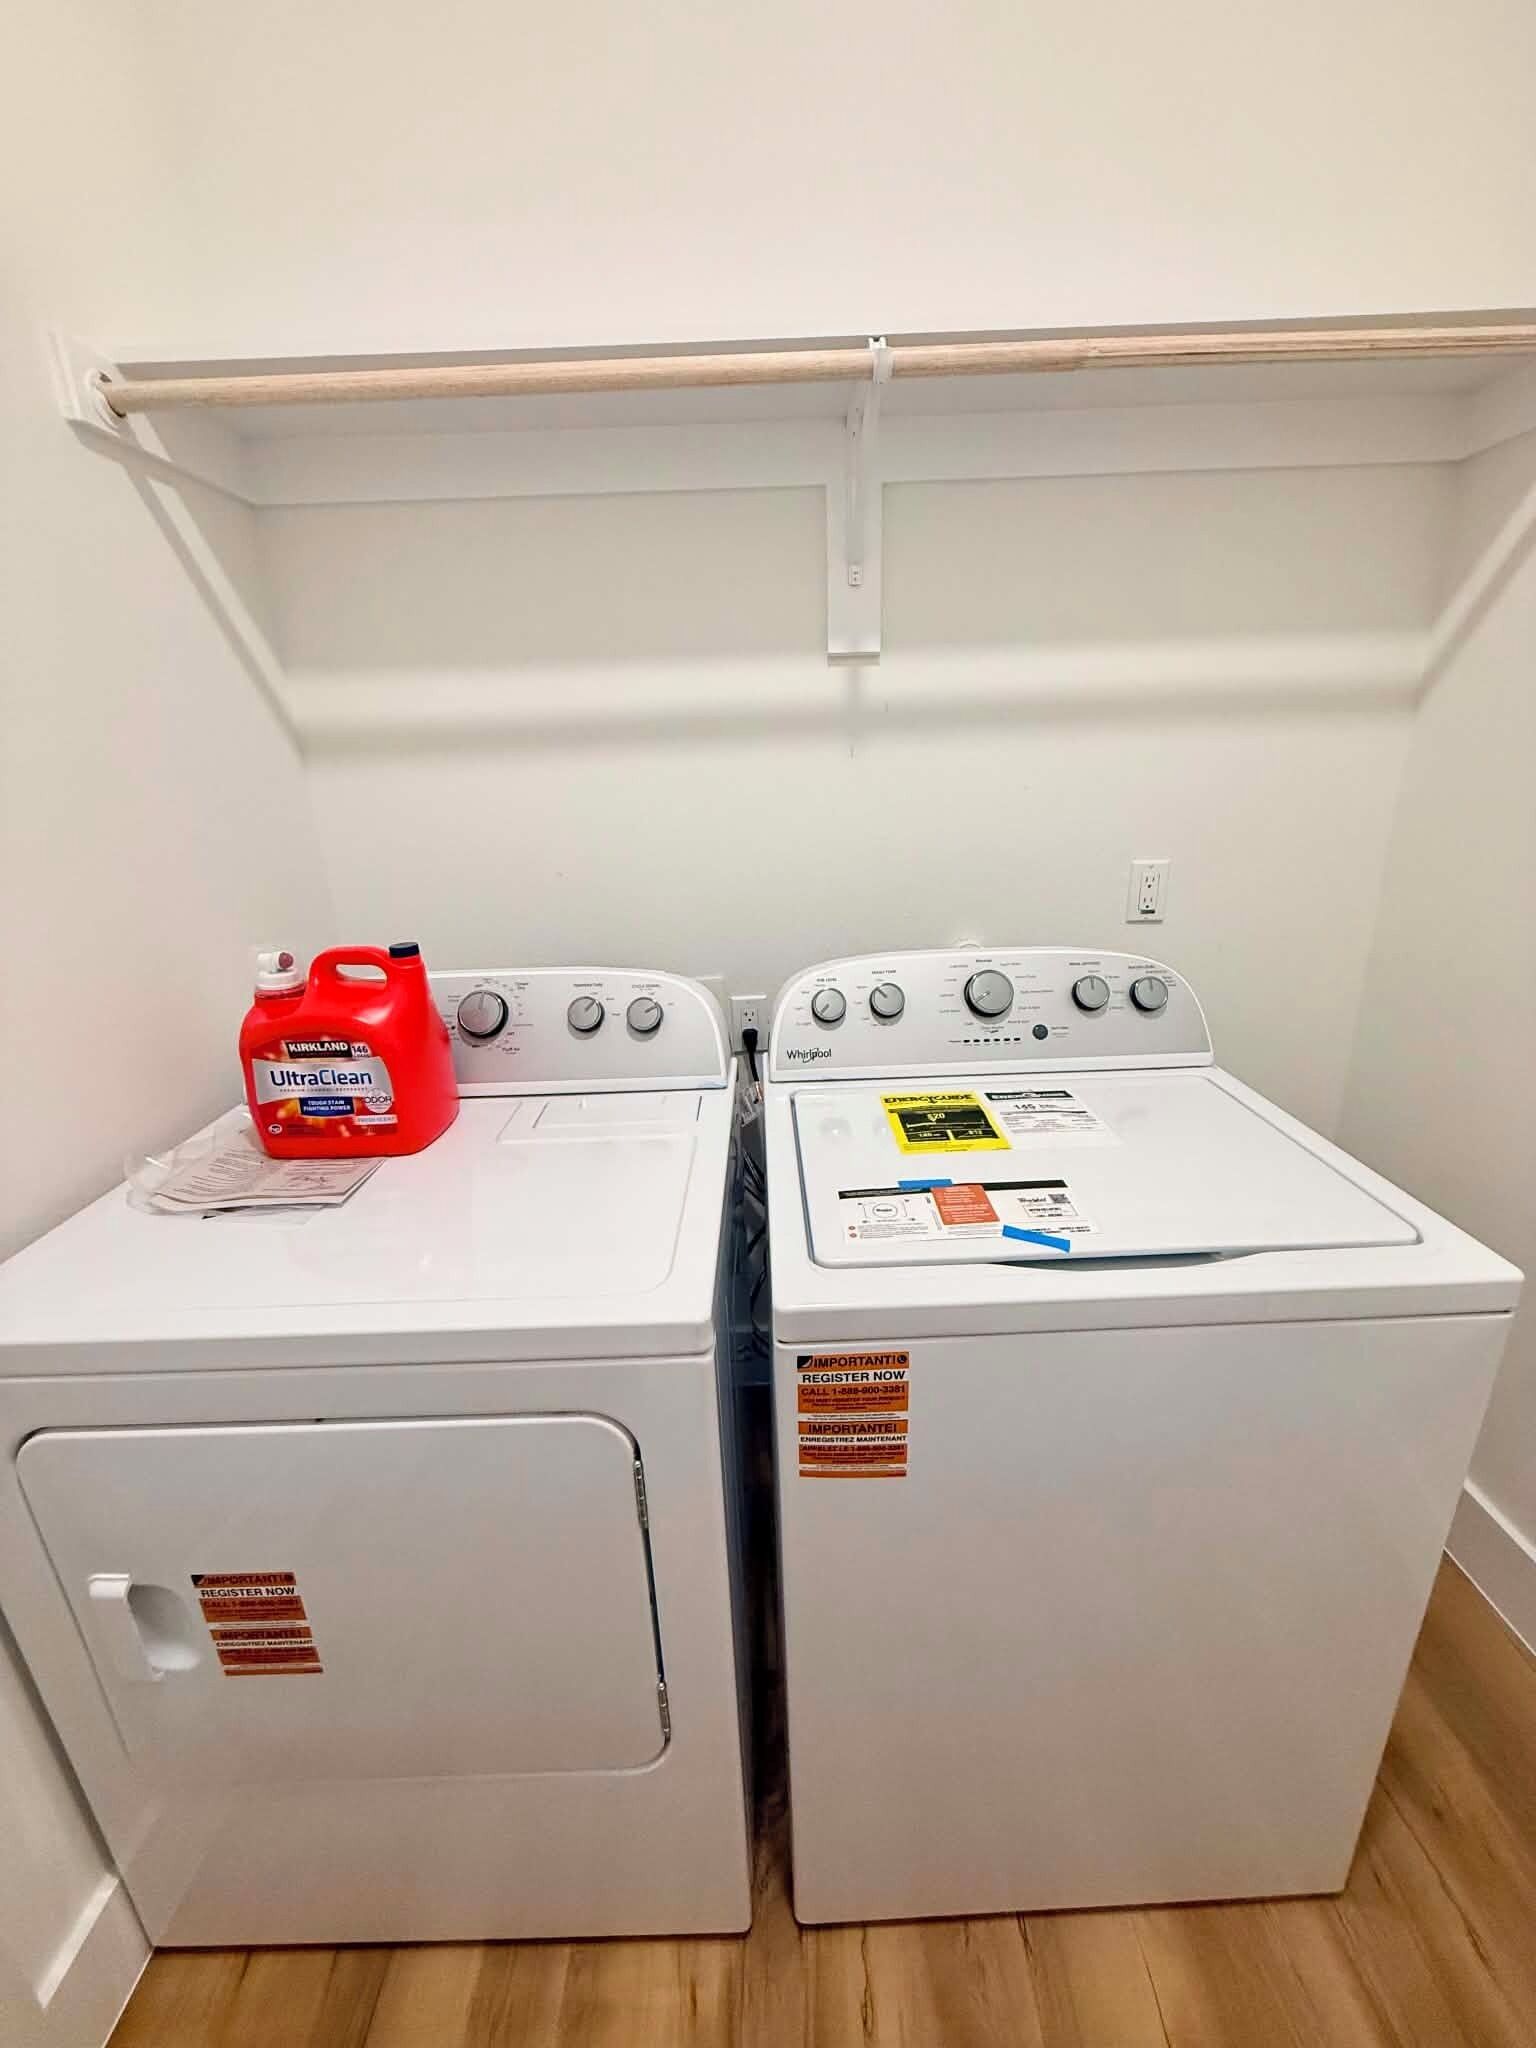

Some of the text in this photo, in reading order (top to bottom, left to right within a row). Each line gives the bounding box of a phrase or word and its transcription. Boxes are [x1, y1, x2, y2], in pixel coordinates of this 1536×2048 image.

[288, 1042, 349, 1053] KIRKLAND
[786, 1047, 832, 1063] Whirlpool
[269, 1069, 373, 1086] UltraClean
[802, 1370, 905, 1383] REGISTER NOW
[801, 1388, 829, 1396] CALL
[200, 1586, 295, 1598] REGISTER NOW
